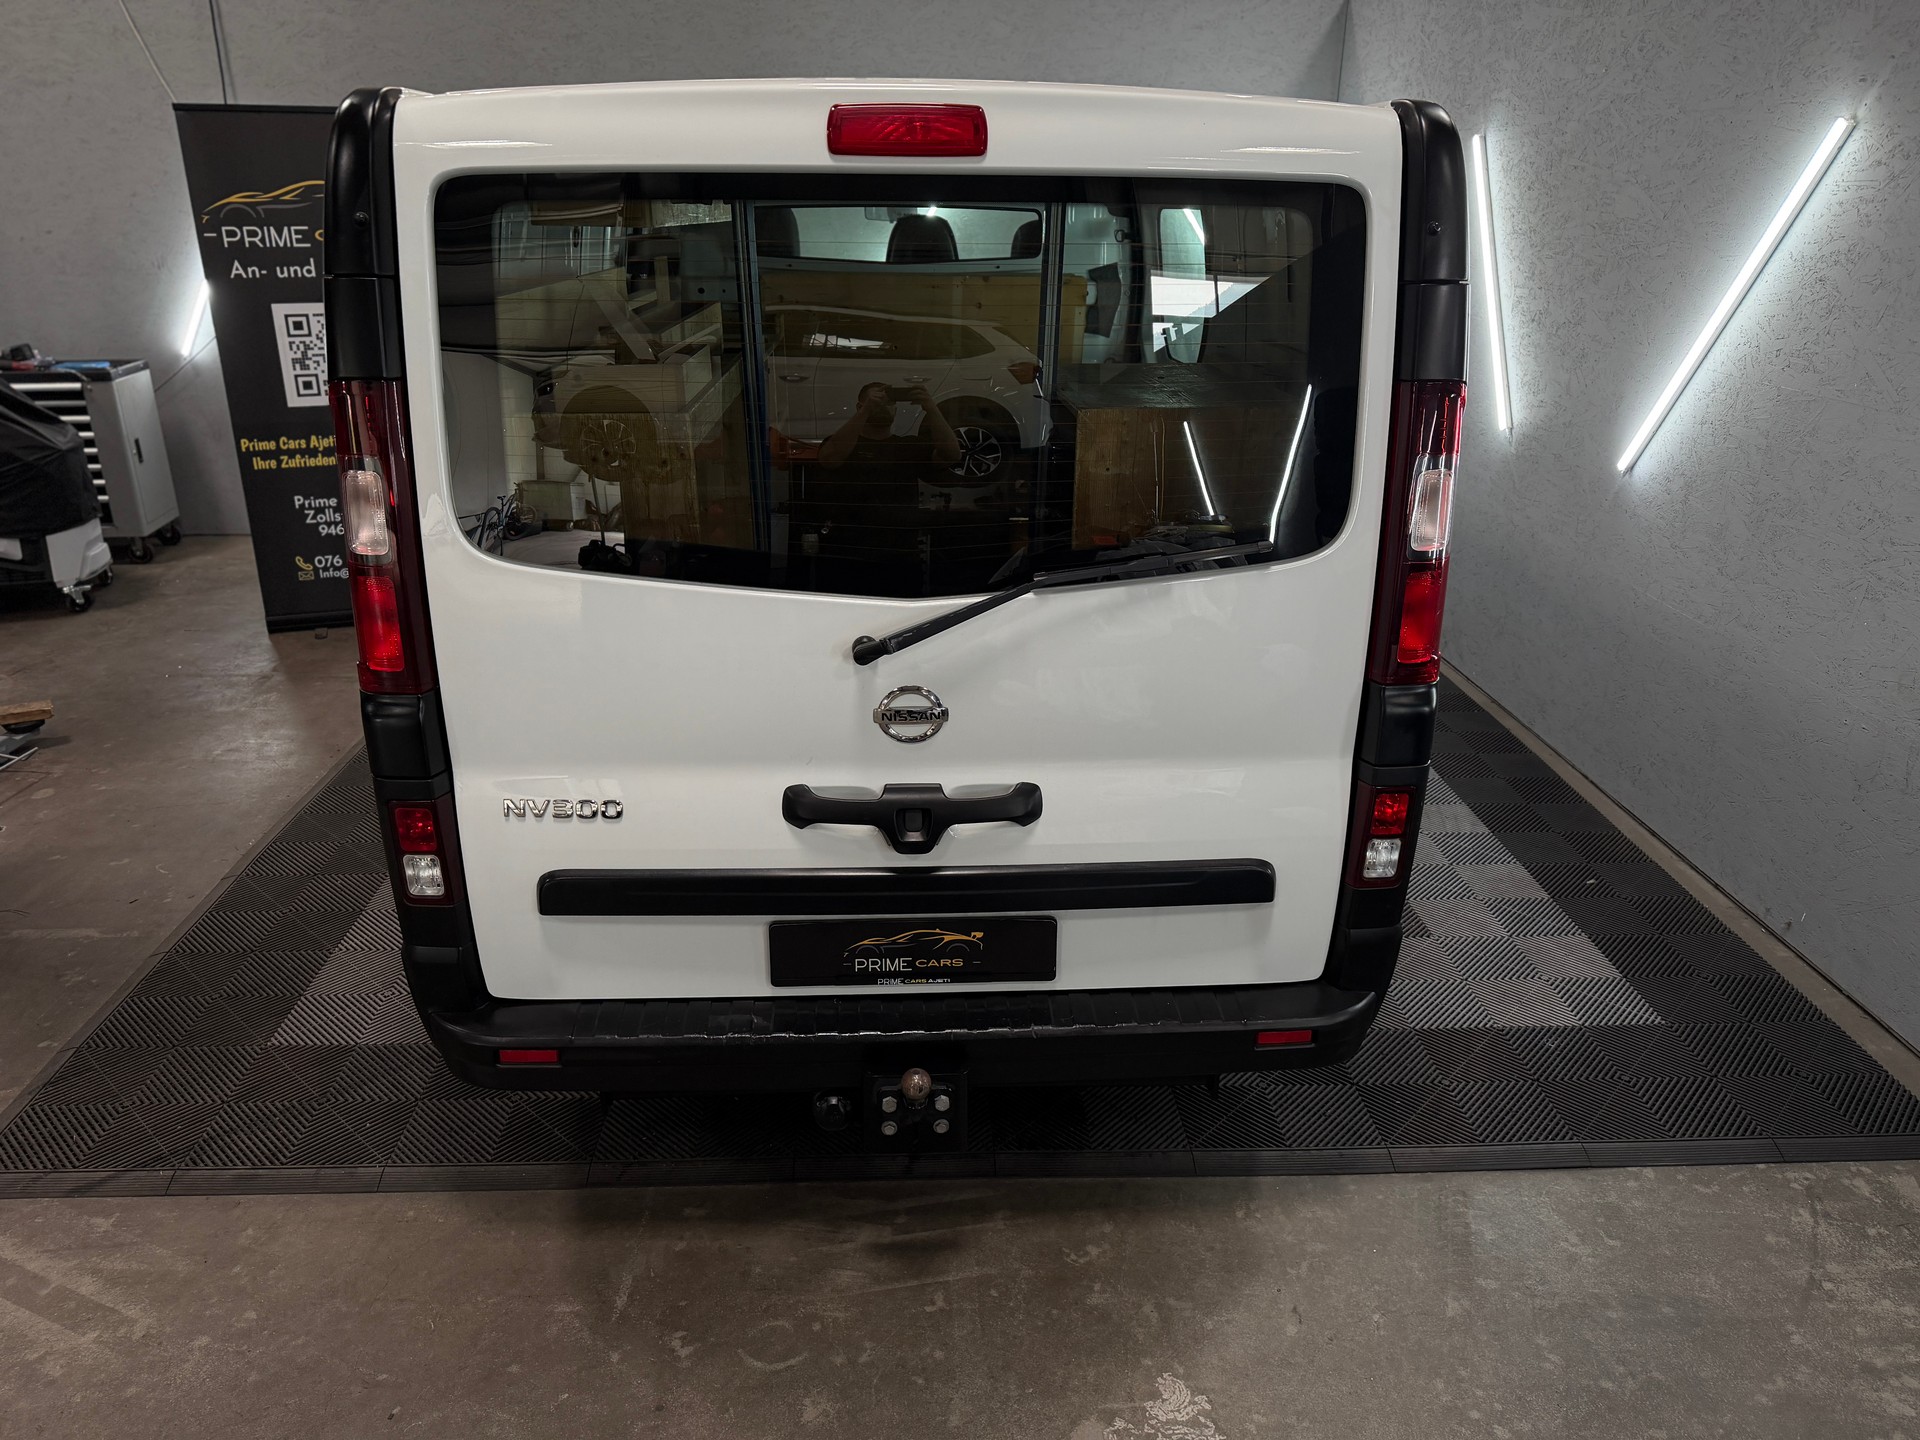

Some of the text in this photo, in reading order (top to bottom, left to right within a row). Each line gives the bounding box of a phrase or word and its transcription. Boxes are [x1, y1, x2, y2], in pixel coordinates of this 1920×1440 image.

[221, 226, 311, 248] PRIME
[230, 257, 316, 279] An- und
[239, 438, 277, 452] Prime
[279, 436, 306, 450] Cars
[252, 453, 338, 470] Ihre Zufrieden
[293, 495, 338, 509] Prime
[304, 508, 343, 524] Zolls
[318, 524, 345, 537] 946
[314, 555, 343, 568] 076
[880, 710, 943, 724] NISSAN
[503, 799, 624, 822] NV300
[854, 957, 964, 973] PRIME CARS
